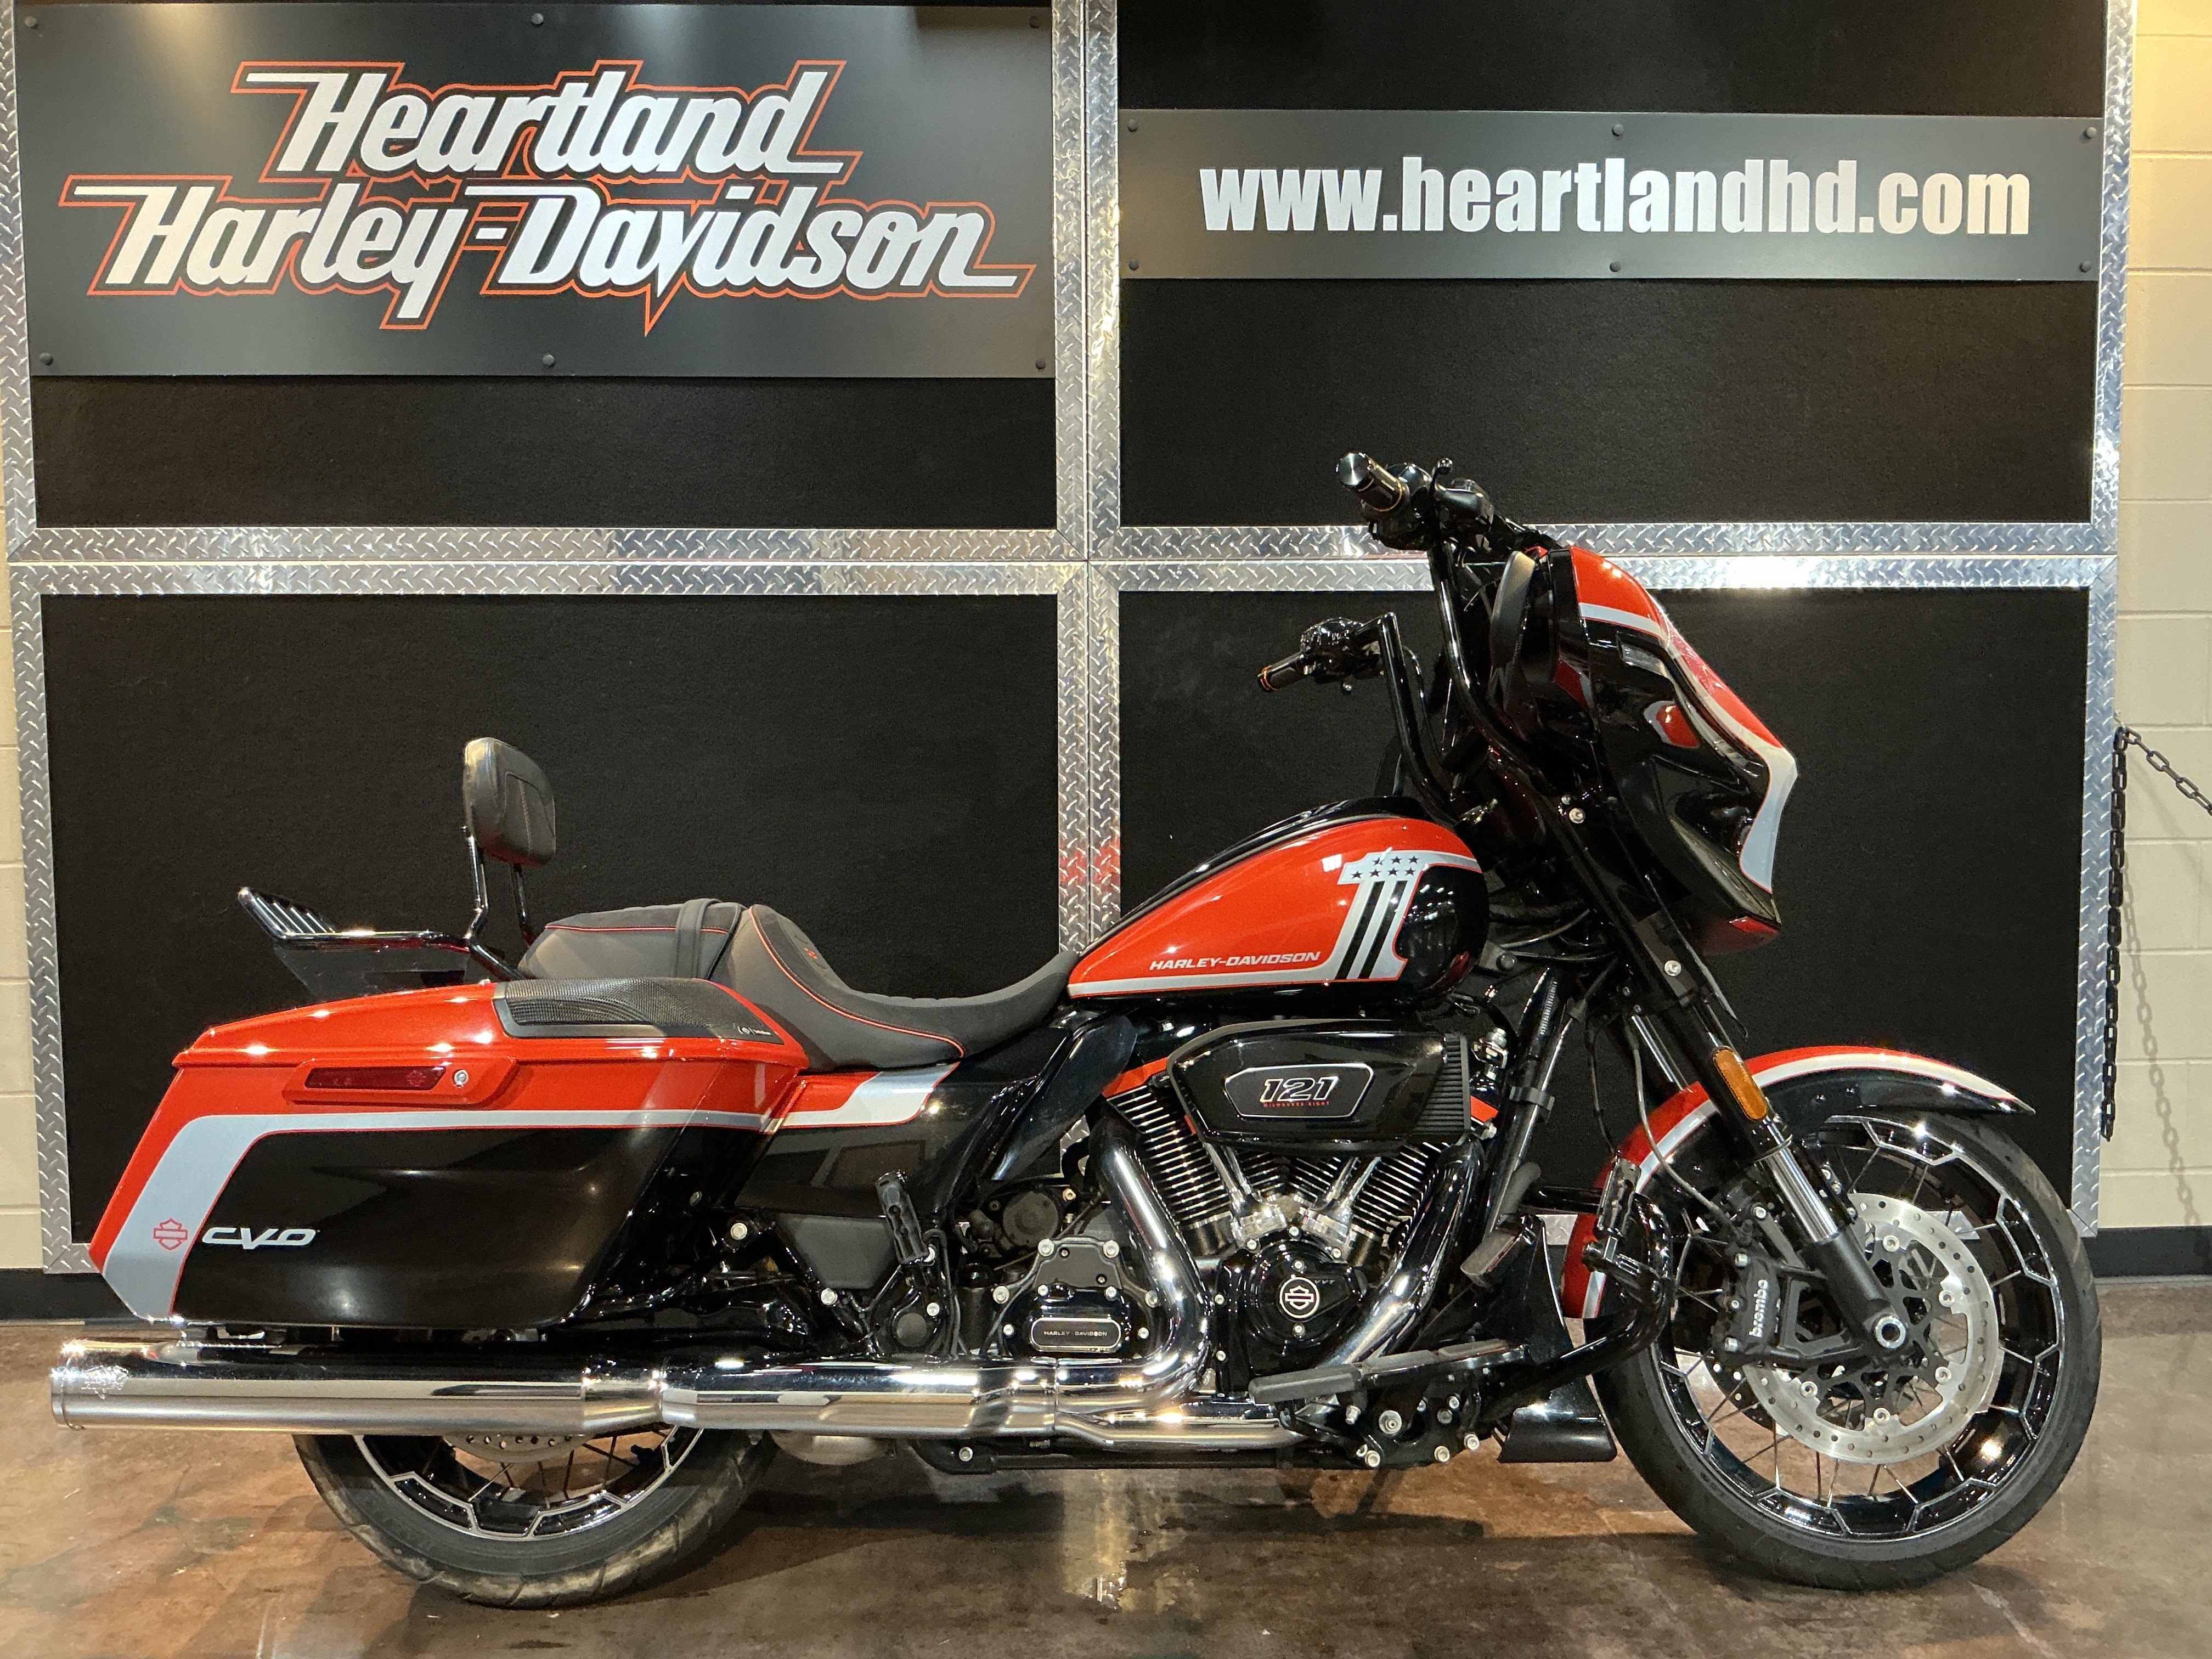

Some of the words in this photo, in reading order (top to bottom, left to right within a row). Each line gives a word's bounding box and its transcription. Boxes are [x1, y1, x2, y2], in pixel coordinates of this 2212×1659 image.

[241, 70, 841, 174] Heartland
[1199, 156, 2030, 236] www.heartlandhd.com
[72, 184, 1036, 319] Harley-Davidson
[1149, 951, 1321, 971] HARLEY-DAVIDSON
[1260, 1076, 1339, 1102] 121
[201, 1226, 317, 1250] CVO
[1748, 1279, 1769, 1338] brembo
